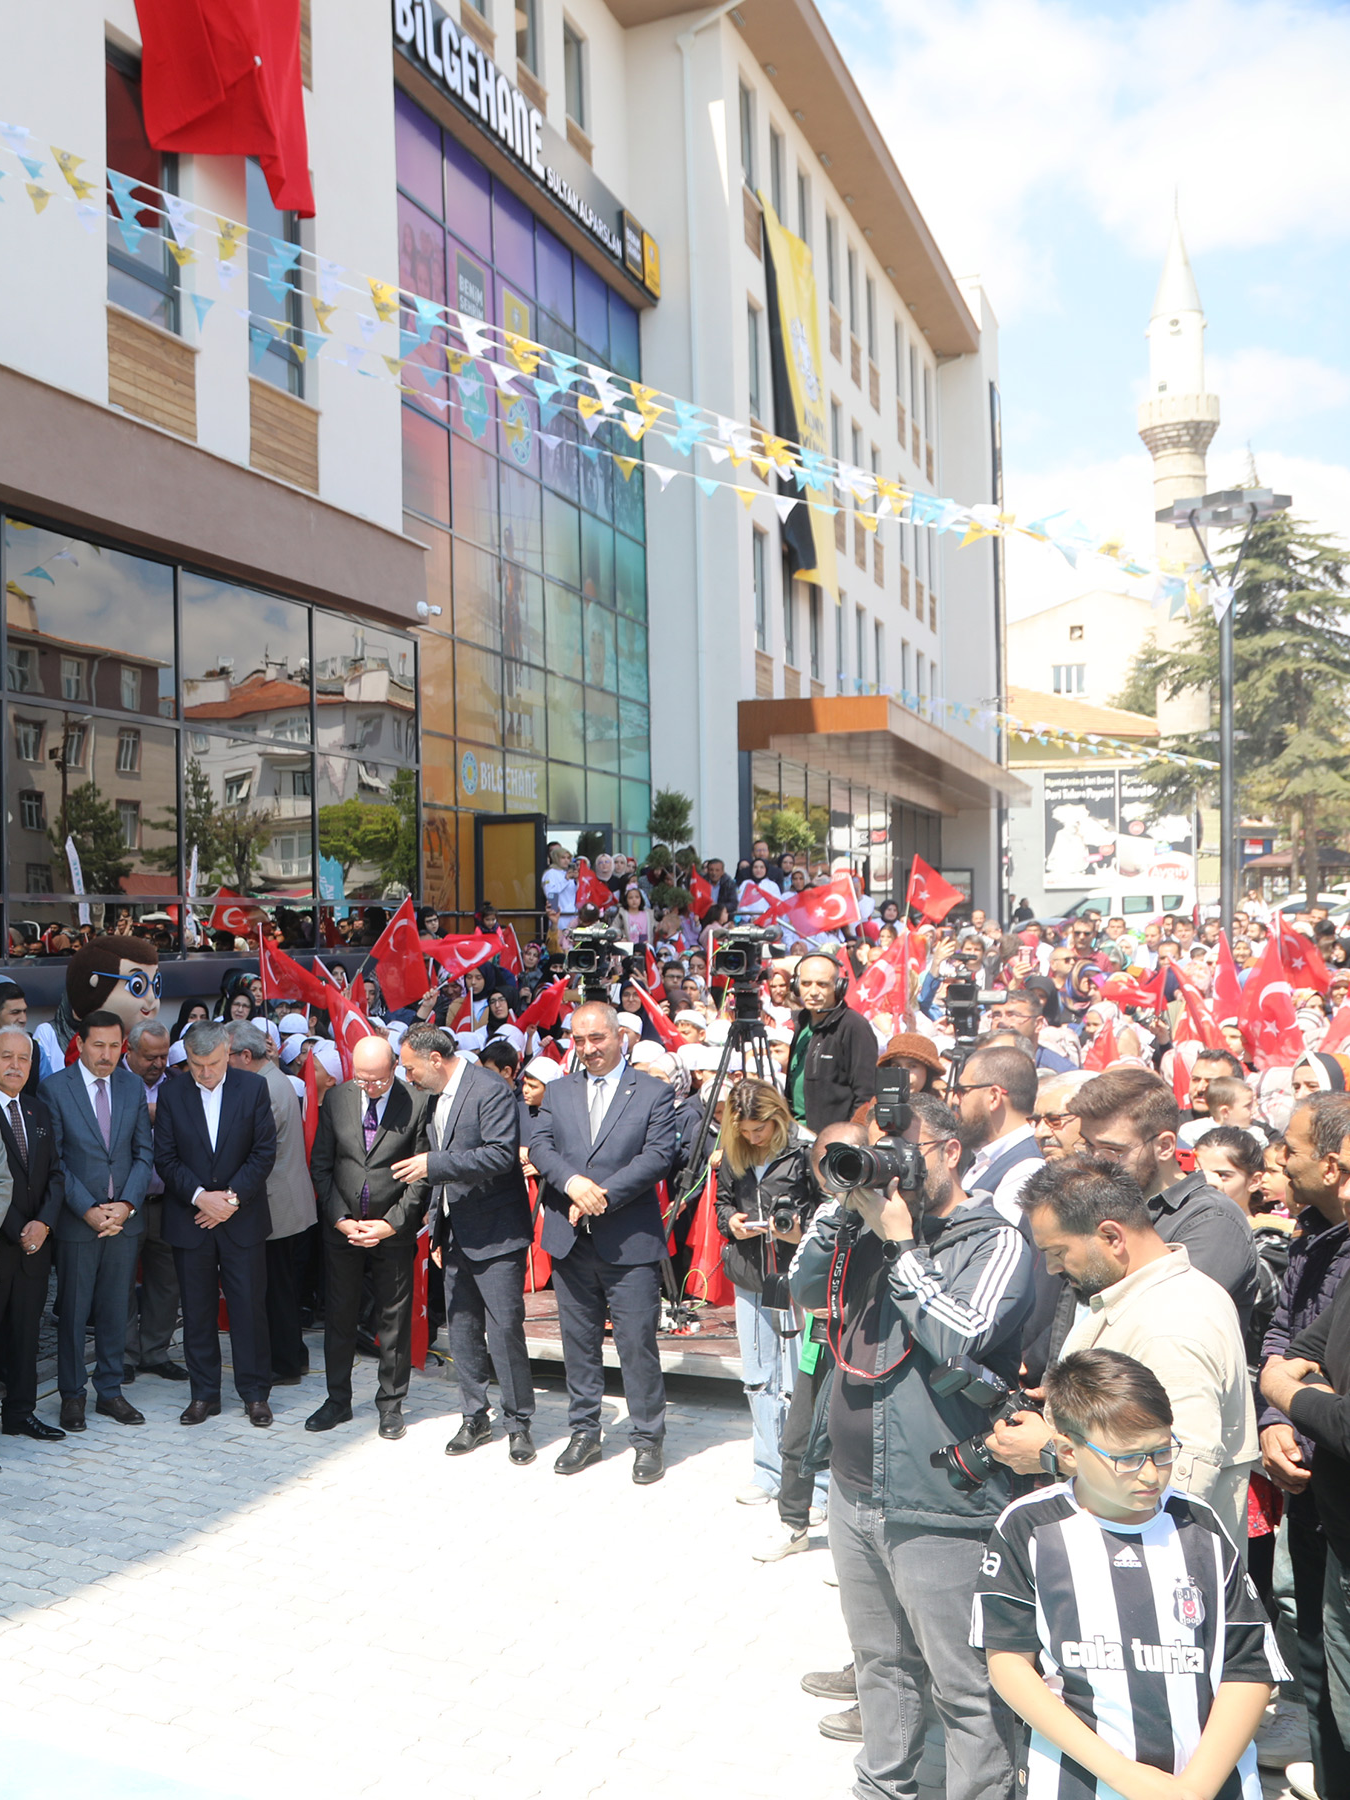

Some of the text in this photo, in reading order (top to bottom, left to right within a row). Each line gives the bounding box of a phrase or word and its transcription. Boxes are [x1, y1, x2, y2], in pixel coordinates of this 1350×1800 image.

[833, 1252, 845, 1278] EOS
[1061, 1635, 1205, 1674] cola turka
